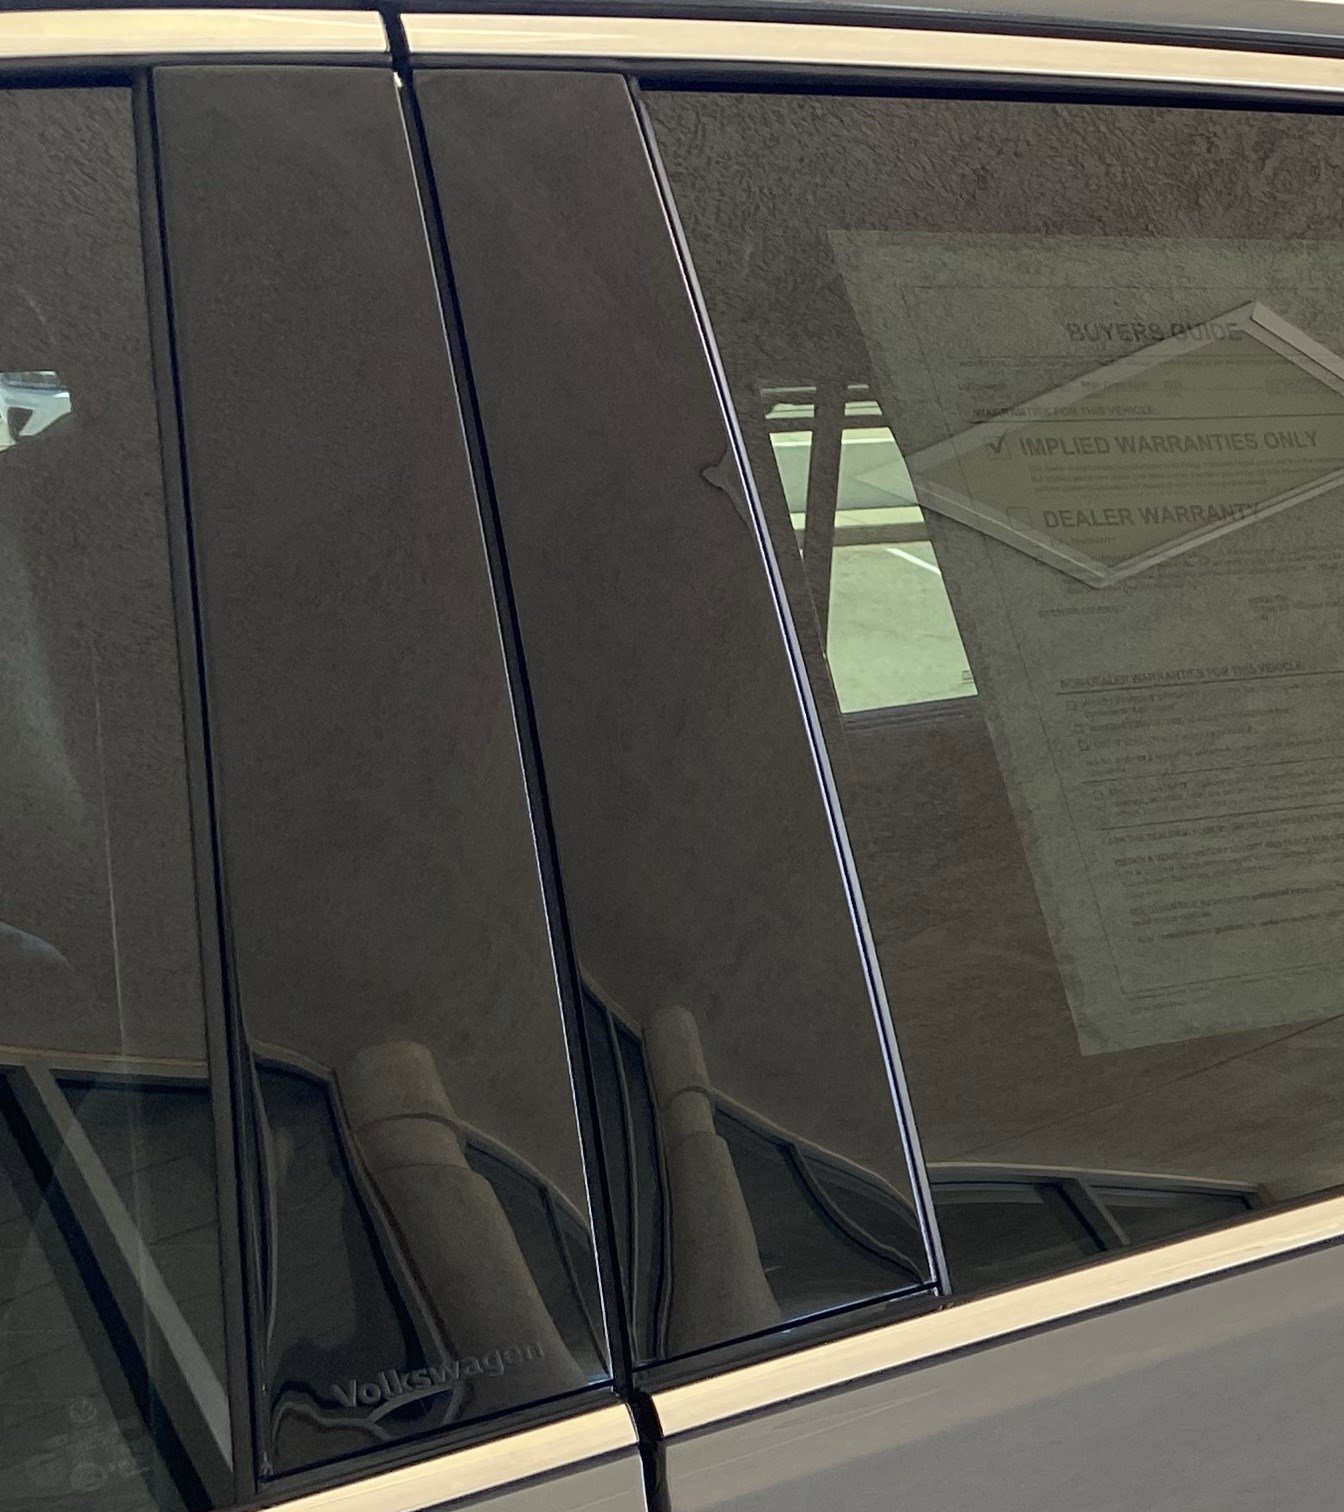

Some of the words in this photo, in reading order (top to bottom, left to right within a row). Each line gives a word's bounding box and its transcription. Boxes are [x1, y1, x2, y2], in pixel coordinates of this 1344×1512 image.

[1065, 322, 1164, 343] BUYERS
[1171, 322, 1244, 341] GUIDE
[1019, 436, 1110, 456] IMPLIED
[1115, 433, 1259, 454] WARRANTIES
[1264, 430, 1318, 450] ONLY
[1043, 507, 1135, 529] DEALER
[1140, 503, 1258, 526] WARRANTY
[332, 1342, 544, 1408] Volkswagen
